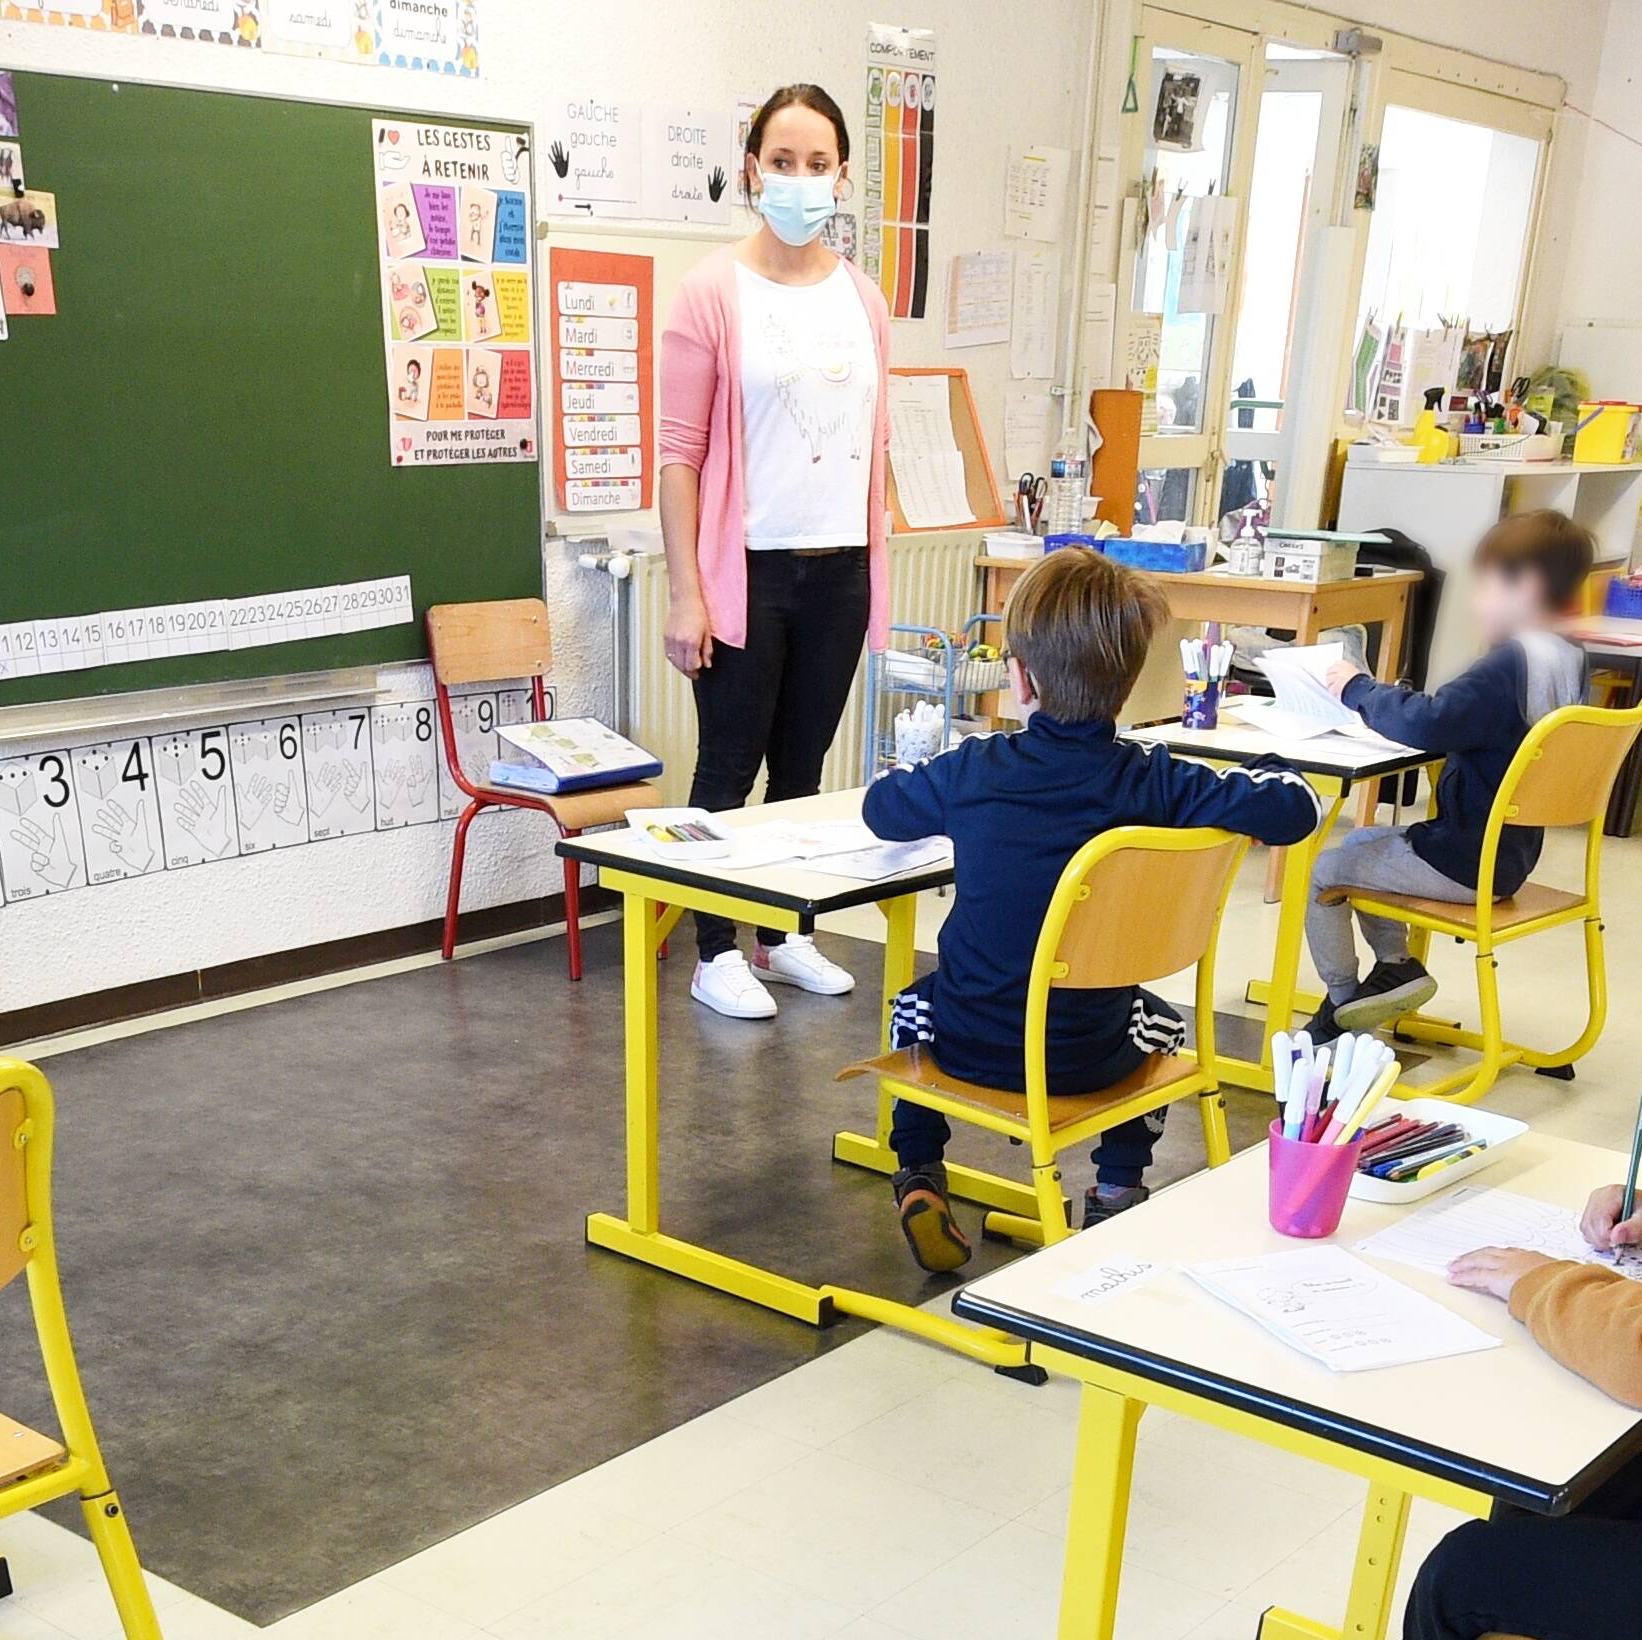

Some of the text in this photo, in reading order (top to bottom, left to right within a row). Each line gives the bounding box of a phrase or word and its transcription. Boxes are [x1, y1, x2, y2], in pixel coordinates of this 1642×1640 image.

[390, 0, 448, 17] dimanche
[289, 11, 332, 28] samedi
[393, 18, 447, 44] dimanche
[567, 103, 619, 123] GAUCHE
[417, 129, 491, 151] LES GESTES
[570, 131, 617, 148] gauche
[668, 126, 707, 145] DROITE
[671, 152, 703, 169] droite
[435, 160, 489, 181] RETENIR
[574, 157, 614, 190] gauche
[671, 184, 703, 201] droite
[565, 293, 595, 311] Lundi
[566, 327, 597, 344] Mardi
[566, 361, 614, 377] Mercredi
[566, 394, 595, 411] Jeudi
[426, 429, 448, 442] POUR
[450, 429, 462, 441] ME
[570, 425, 618, 442] Vendredi
[414, 448, 424, 461] ET
[471, 447, 486, 459] LES
[487, 446, 517, 459] AUTRES
[572, 459, 611, 474] Samedi
[572, 491, 620, 506] Dimanche
[15, 632, 34, 651] 12
[39, 629, 59, 648] 13
[62, 627, 81, 646] 14
[85, 623, 102, 644] 15
[107, 620, 125, 640] 16
[128, 618, 144, 637] 17
[148, 616, 166, 635] 18
[168, 614, 186, 632] 19
[188, 611, 207, 631] 20
[208, 611, 226, 629] 21
[229, 609, 247, 627] 22
[248, 606, 266, 624] 23
[267, 603, 284, 621] 24
[286, 601, 304, 618] 25
[305, 598, 323, 616] 26
[324, 596, 340, 614] 27
[343, 594, 359, 611] 28
[360, 591, 377, 607] 29
[378, 588, 394, 605] 30
[395, 585, 409, 603] 31
[38, 755, 71, 808] 3
[121, 742, 149, 792] 4
[200, 731, 226, 781] 5
[279, 723, 298, 760] 6
[348, 714, 365, 750] 7
[416, 707, 432, 741] 8
[477, 699, 493, 734] 9
[171, 855, 189, 867] cinq
[93, 867, 121, 882] quatre
[11, 886, 32, 898] trois
[1081, 1261, 1153, 1299] mathis
